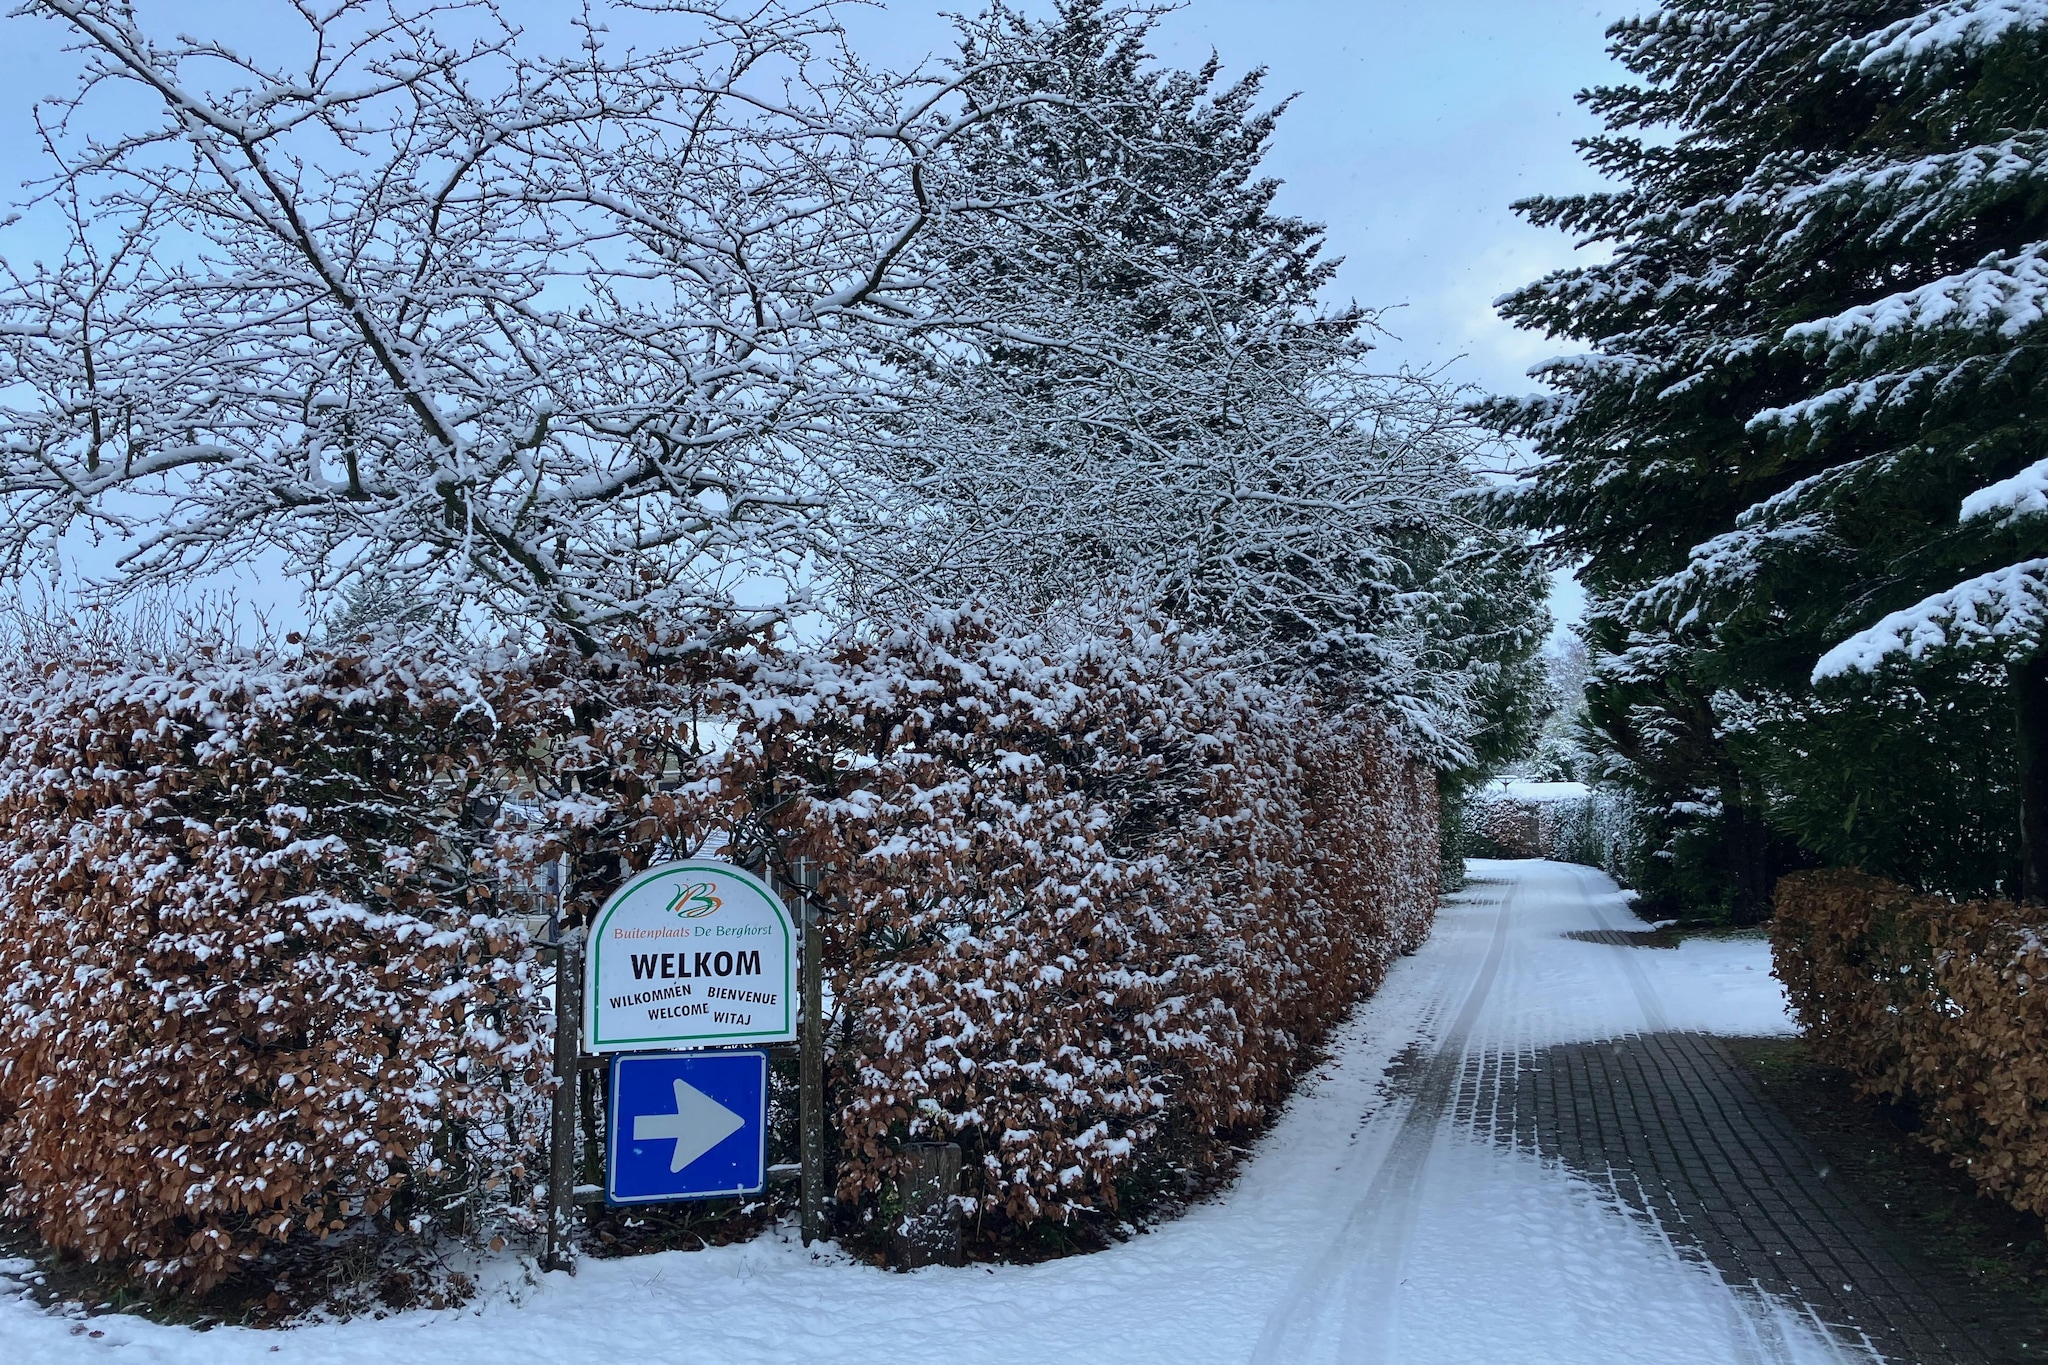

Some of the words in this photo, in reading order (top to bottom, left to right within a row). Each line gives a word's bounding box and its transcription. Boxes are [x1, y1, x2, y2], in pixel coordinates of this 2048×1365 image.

[614, 927, 690, 940] Buitenplaats
[694, 926, 712, 937] De
[716, 924, 772, 939] Berghorst
[631, 950, 761, 980] WELKOM
[610, 984, 692, 1009] WILKOMMEN
[708, 987, 778, 1005] BIENVENUE
[648, 1003, 709, 1021] WELCOME
[714, 1011, 751, 1026] WITAJ
